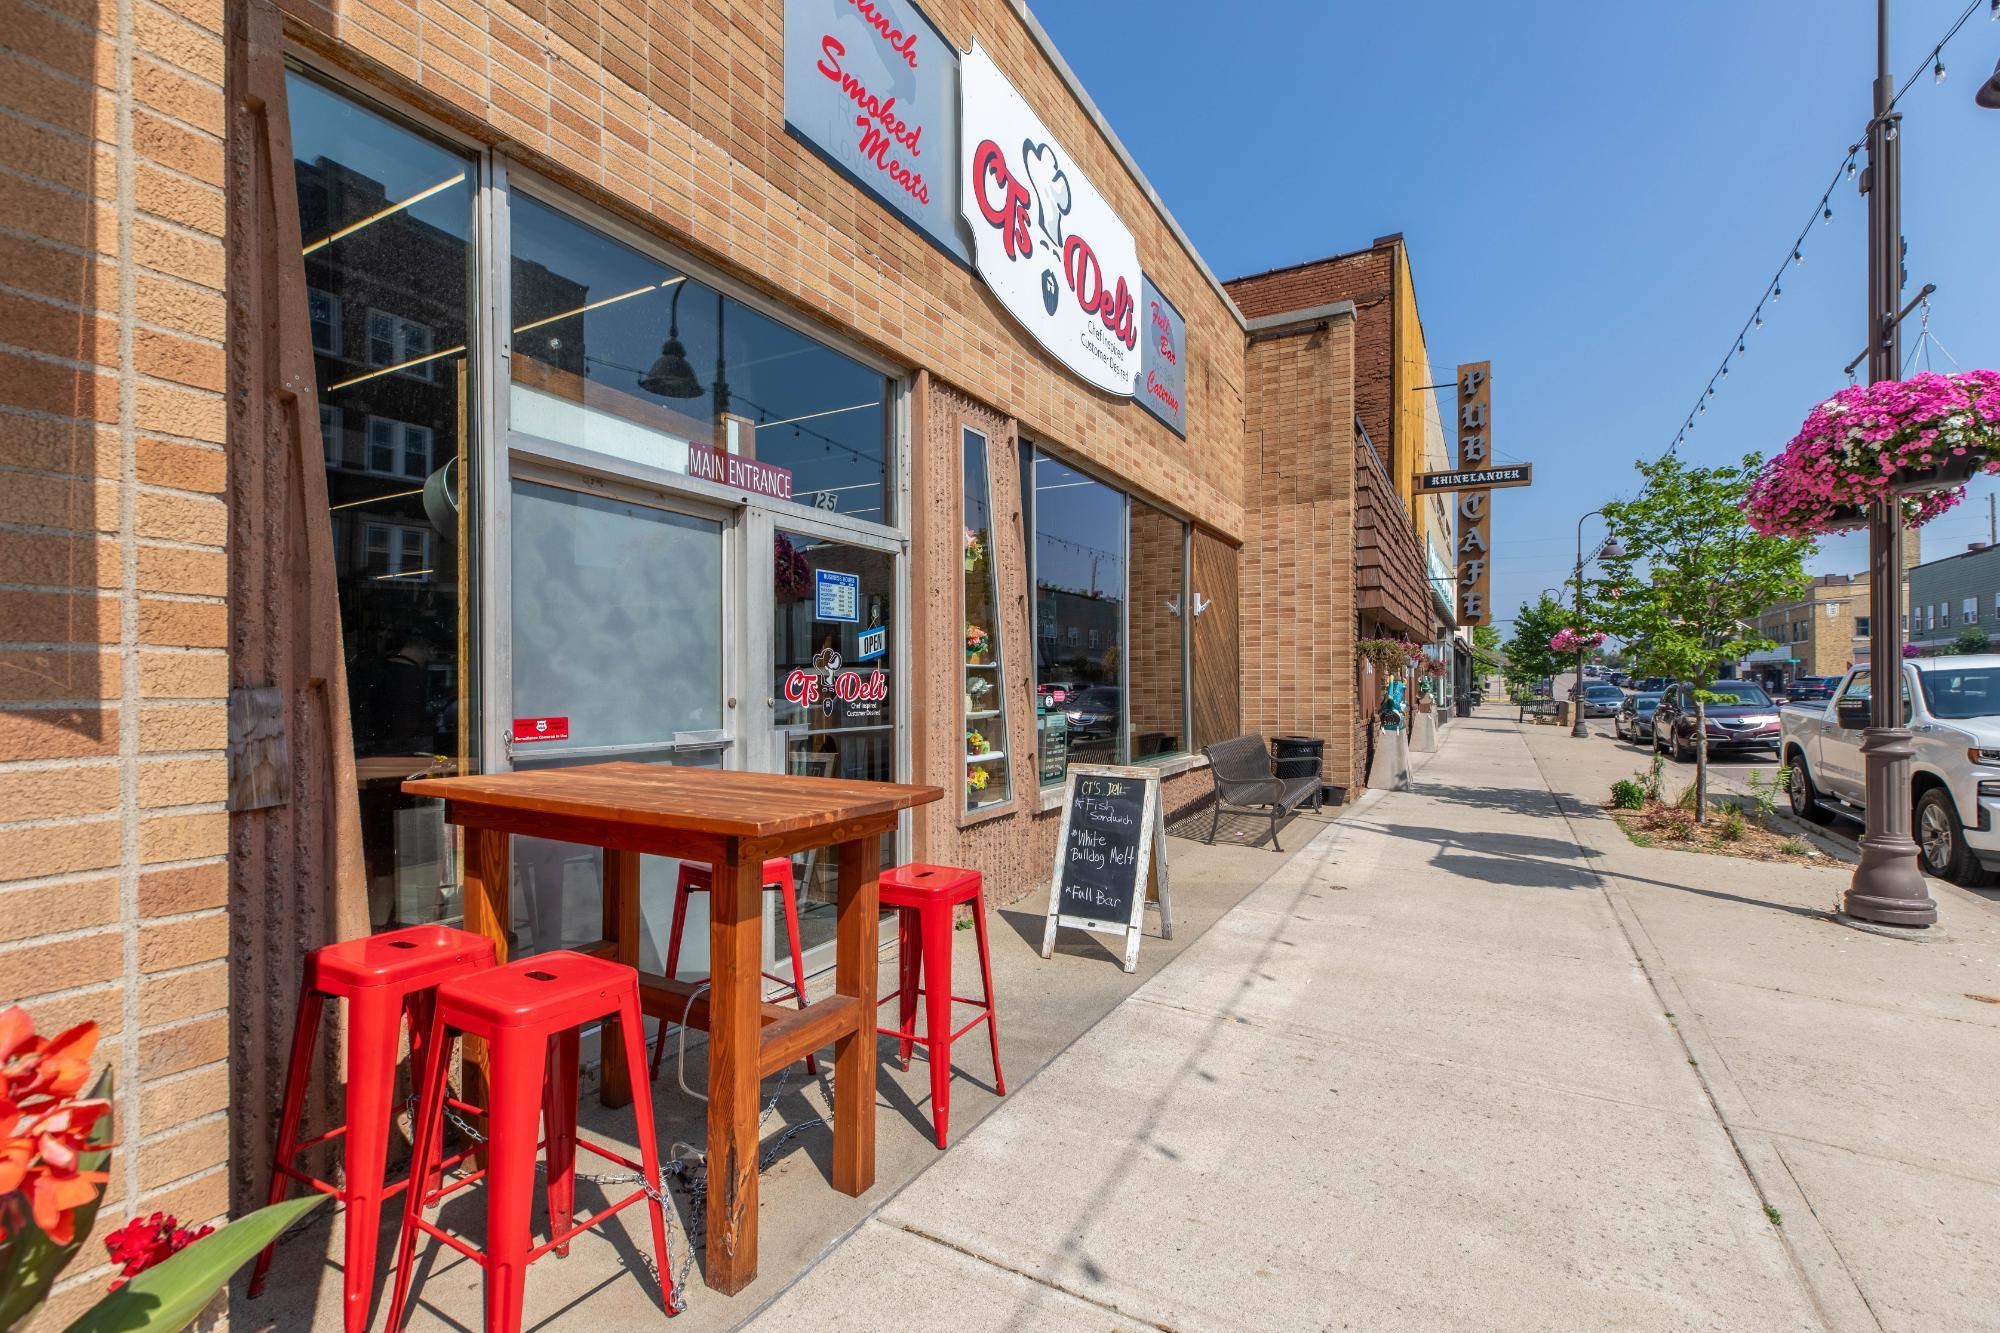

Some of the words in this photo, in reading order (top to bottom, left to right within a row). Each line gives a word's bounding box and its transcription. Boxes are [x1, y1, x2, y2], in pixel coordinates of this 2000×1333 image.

[849, 0, 918, 68] unch
[816, 34, 922, 157] Smoked
[856, 114, 930, 205] Meats
[1063, 234, 1138, 351] Deli
[1160, 335, 1177, 366] Bar
[1147, 369, 1179, 417] Catering
[1462, 369, 1487, 462] PUB
[689, 447, 726, 482] MAIN
[729, 459, 792, 499] ENTRANCE
[1431, 469, 1520, 486] RHINELANDER
[817, 492, 836, 512] 25
[1460, 493, 1487, 618] CAFE
[863, 632, 883, 655] OPEN
[835, 669, 888, 703] Deli
[1086, 798, 1115, 813] Fish
[1078, 829, 1107, 847] White
[1070, 847, 1105, 870] Bulldog
[1109, 845, 1135, 865] Melt
[1095, 889, 1121, 908] Bar
